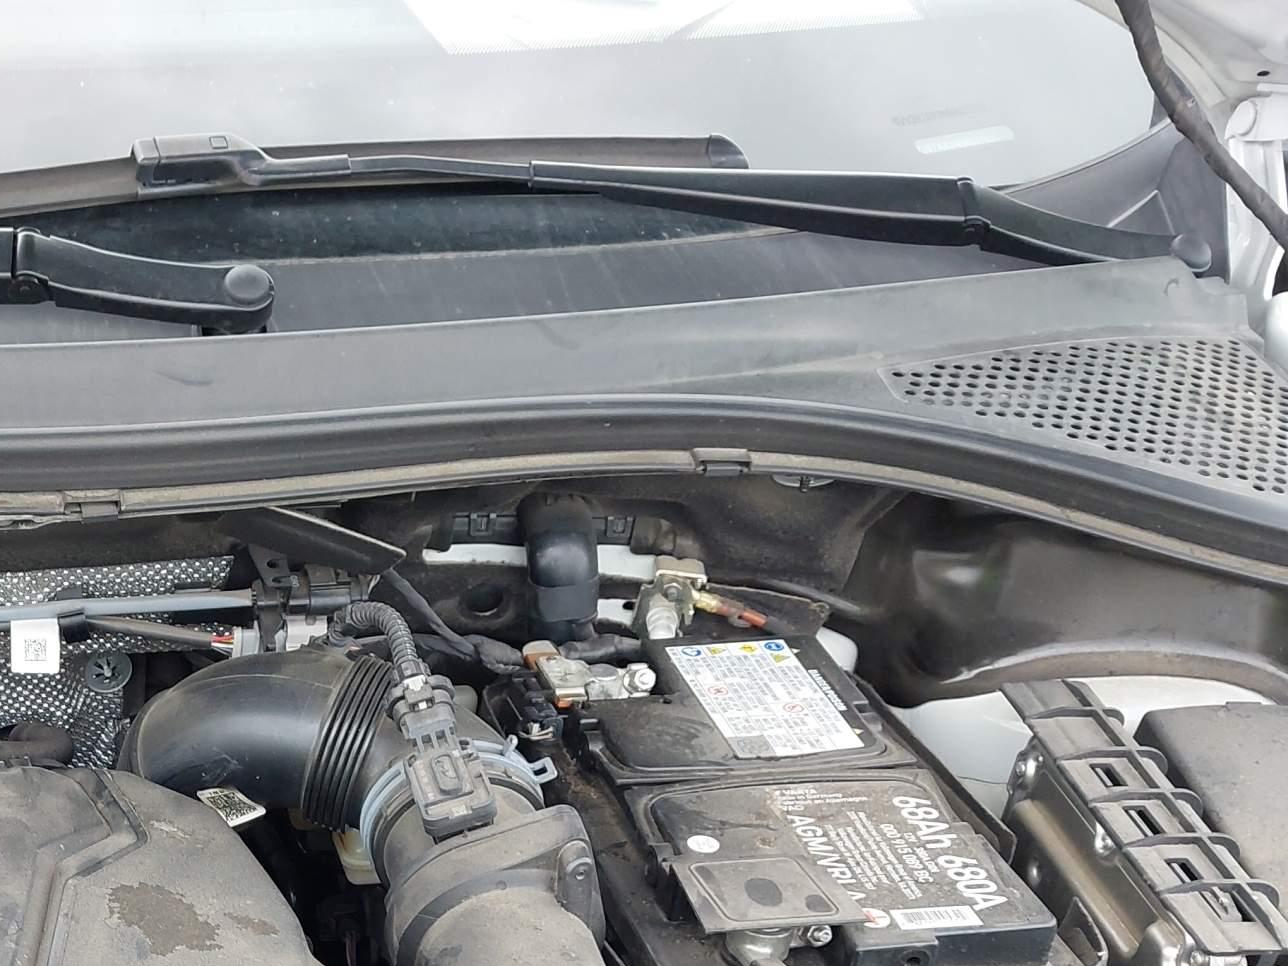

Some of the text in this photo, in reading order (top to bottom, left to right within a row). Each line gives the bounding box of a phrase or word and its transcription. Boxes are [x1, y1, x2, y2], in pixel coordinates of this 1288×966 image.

[891, 838, 912, 854] 915
[892, 796, 957, 849] 68Ah
[936, 854, 1008, 911] 680A
